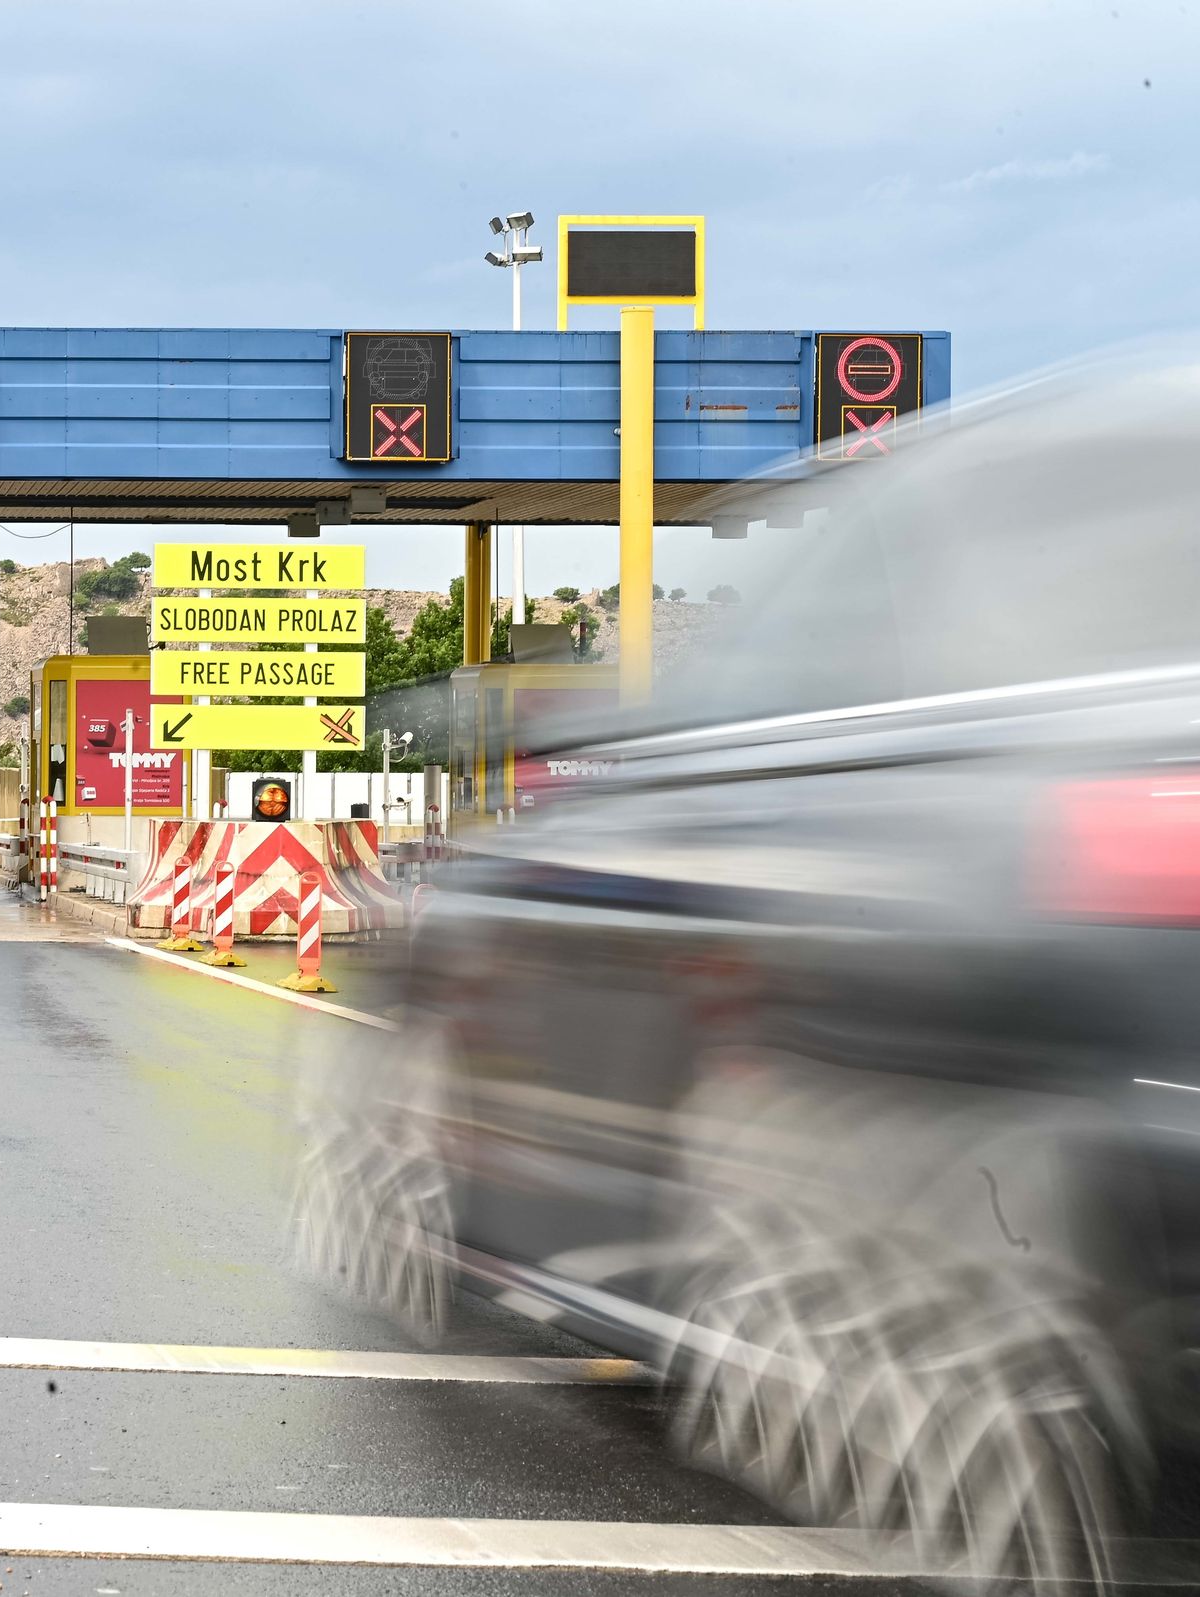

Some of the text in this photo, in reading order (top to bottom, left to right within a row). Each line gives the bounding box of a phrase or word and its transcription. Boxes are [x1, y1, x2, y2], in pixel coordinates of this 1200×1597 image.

[191, 550, 327, 582] Most Krk
[160, 607, 357, 632] SLOBODAN PROLAZ
[180, 662, 335, 686] FREE PASSAGE
[88, 724, 106, 732] 385
[546, 760, 614, 776] TOMMY
